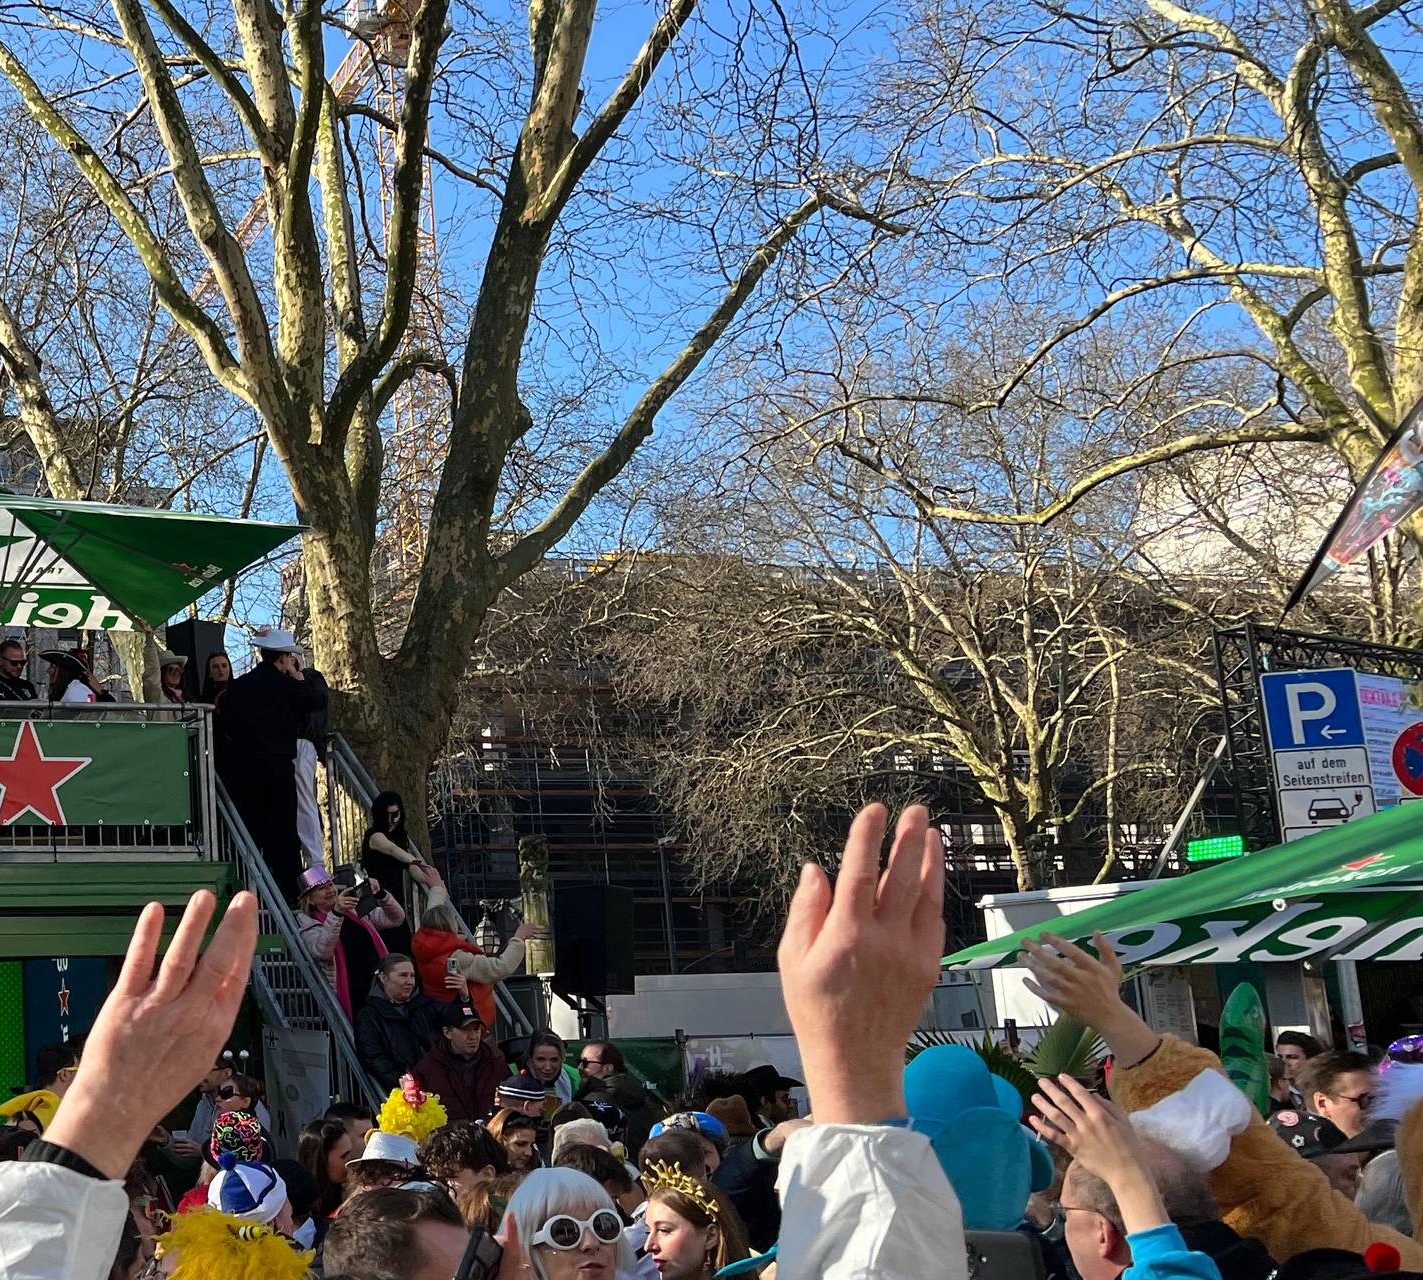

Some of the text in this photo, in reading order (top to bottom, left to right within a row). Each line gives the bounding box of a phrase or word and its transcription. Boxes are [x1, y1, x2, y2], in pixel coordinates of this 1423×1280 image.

[1285, 682, 1337, 745] P
[1297, 757, 1347, 770] auf dem
[1283, 771, 1365, 787] Seitenstreifen
